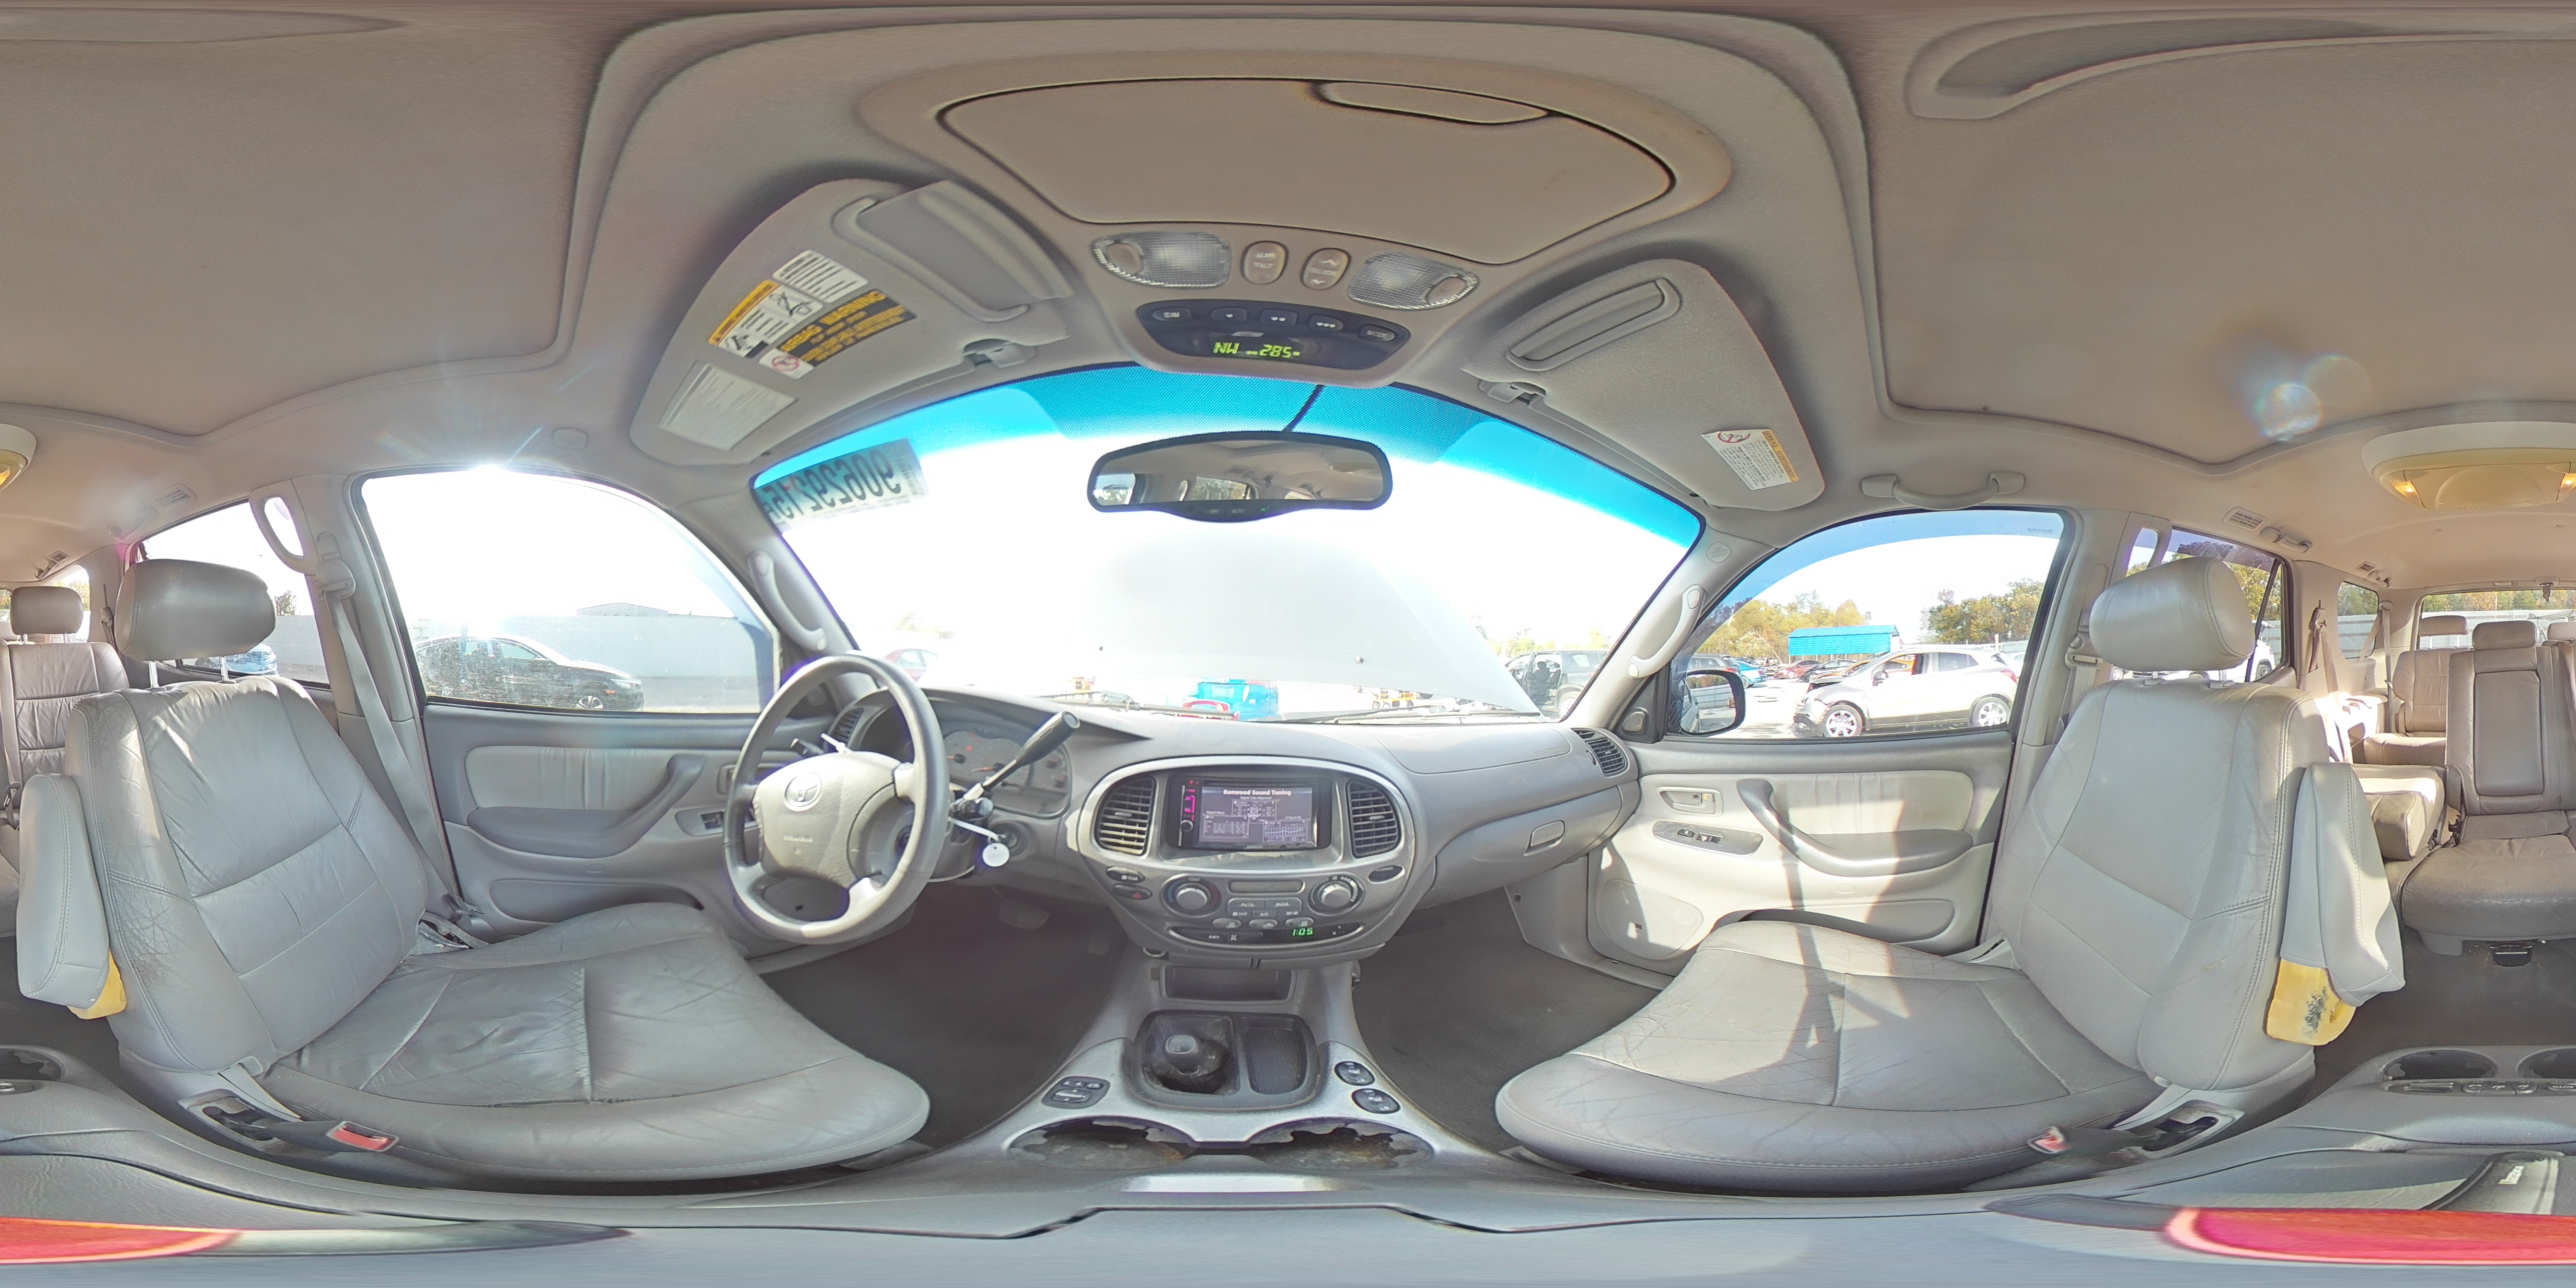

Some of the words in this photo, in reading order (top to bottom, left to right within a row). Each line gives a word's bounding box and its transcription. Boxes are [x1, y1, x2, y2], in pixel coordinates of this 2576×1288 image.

[1307, 267, 1339, 276] SLIDE
[780, 324, 823, 352] AIRBAG
[1213, 342, 1240, 354] NW
[1259, 345, 1292, 358] 285
[1764, 431, 1779, 448] ARNING
[1292, 928, 1313, 936] 1:05
